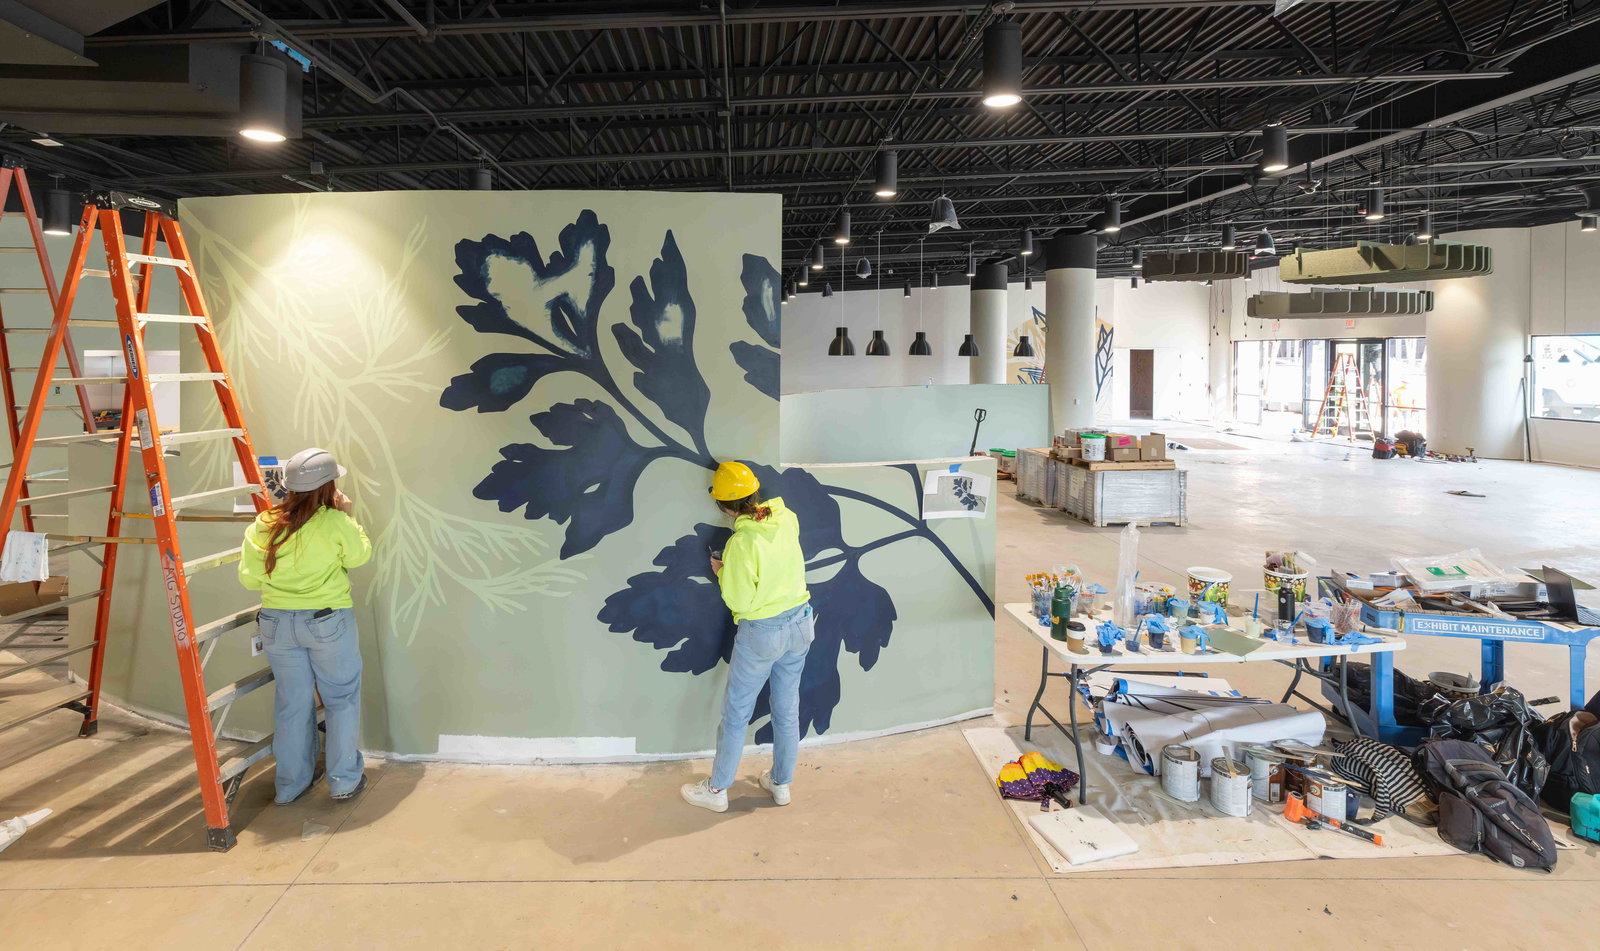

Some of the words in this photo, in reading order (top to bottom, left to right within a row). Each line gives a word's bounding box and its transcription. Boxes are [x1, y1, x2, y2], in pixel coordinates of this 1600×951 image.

[170, 594, 186, 641] STUDIO
[1417, 621, 1458, 632] EXHIBIT
[1461, 623, 1540, 637] MAINTENANCE
